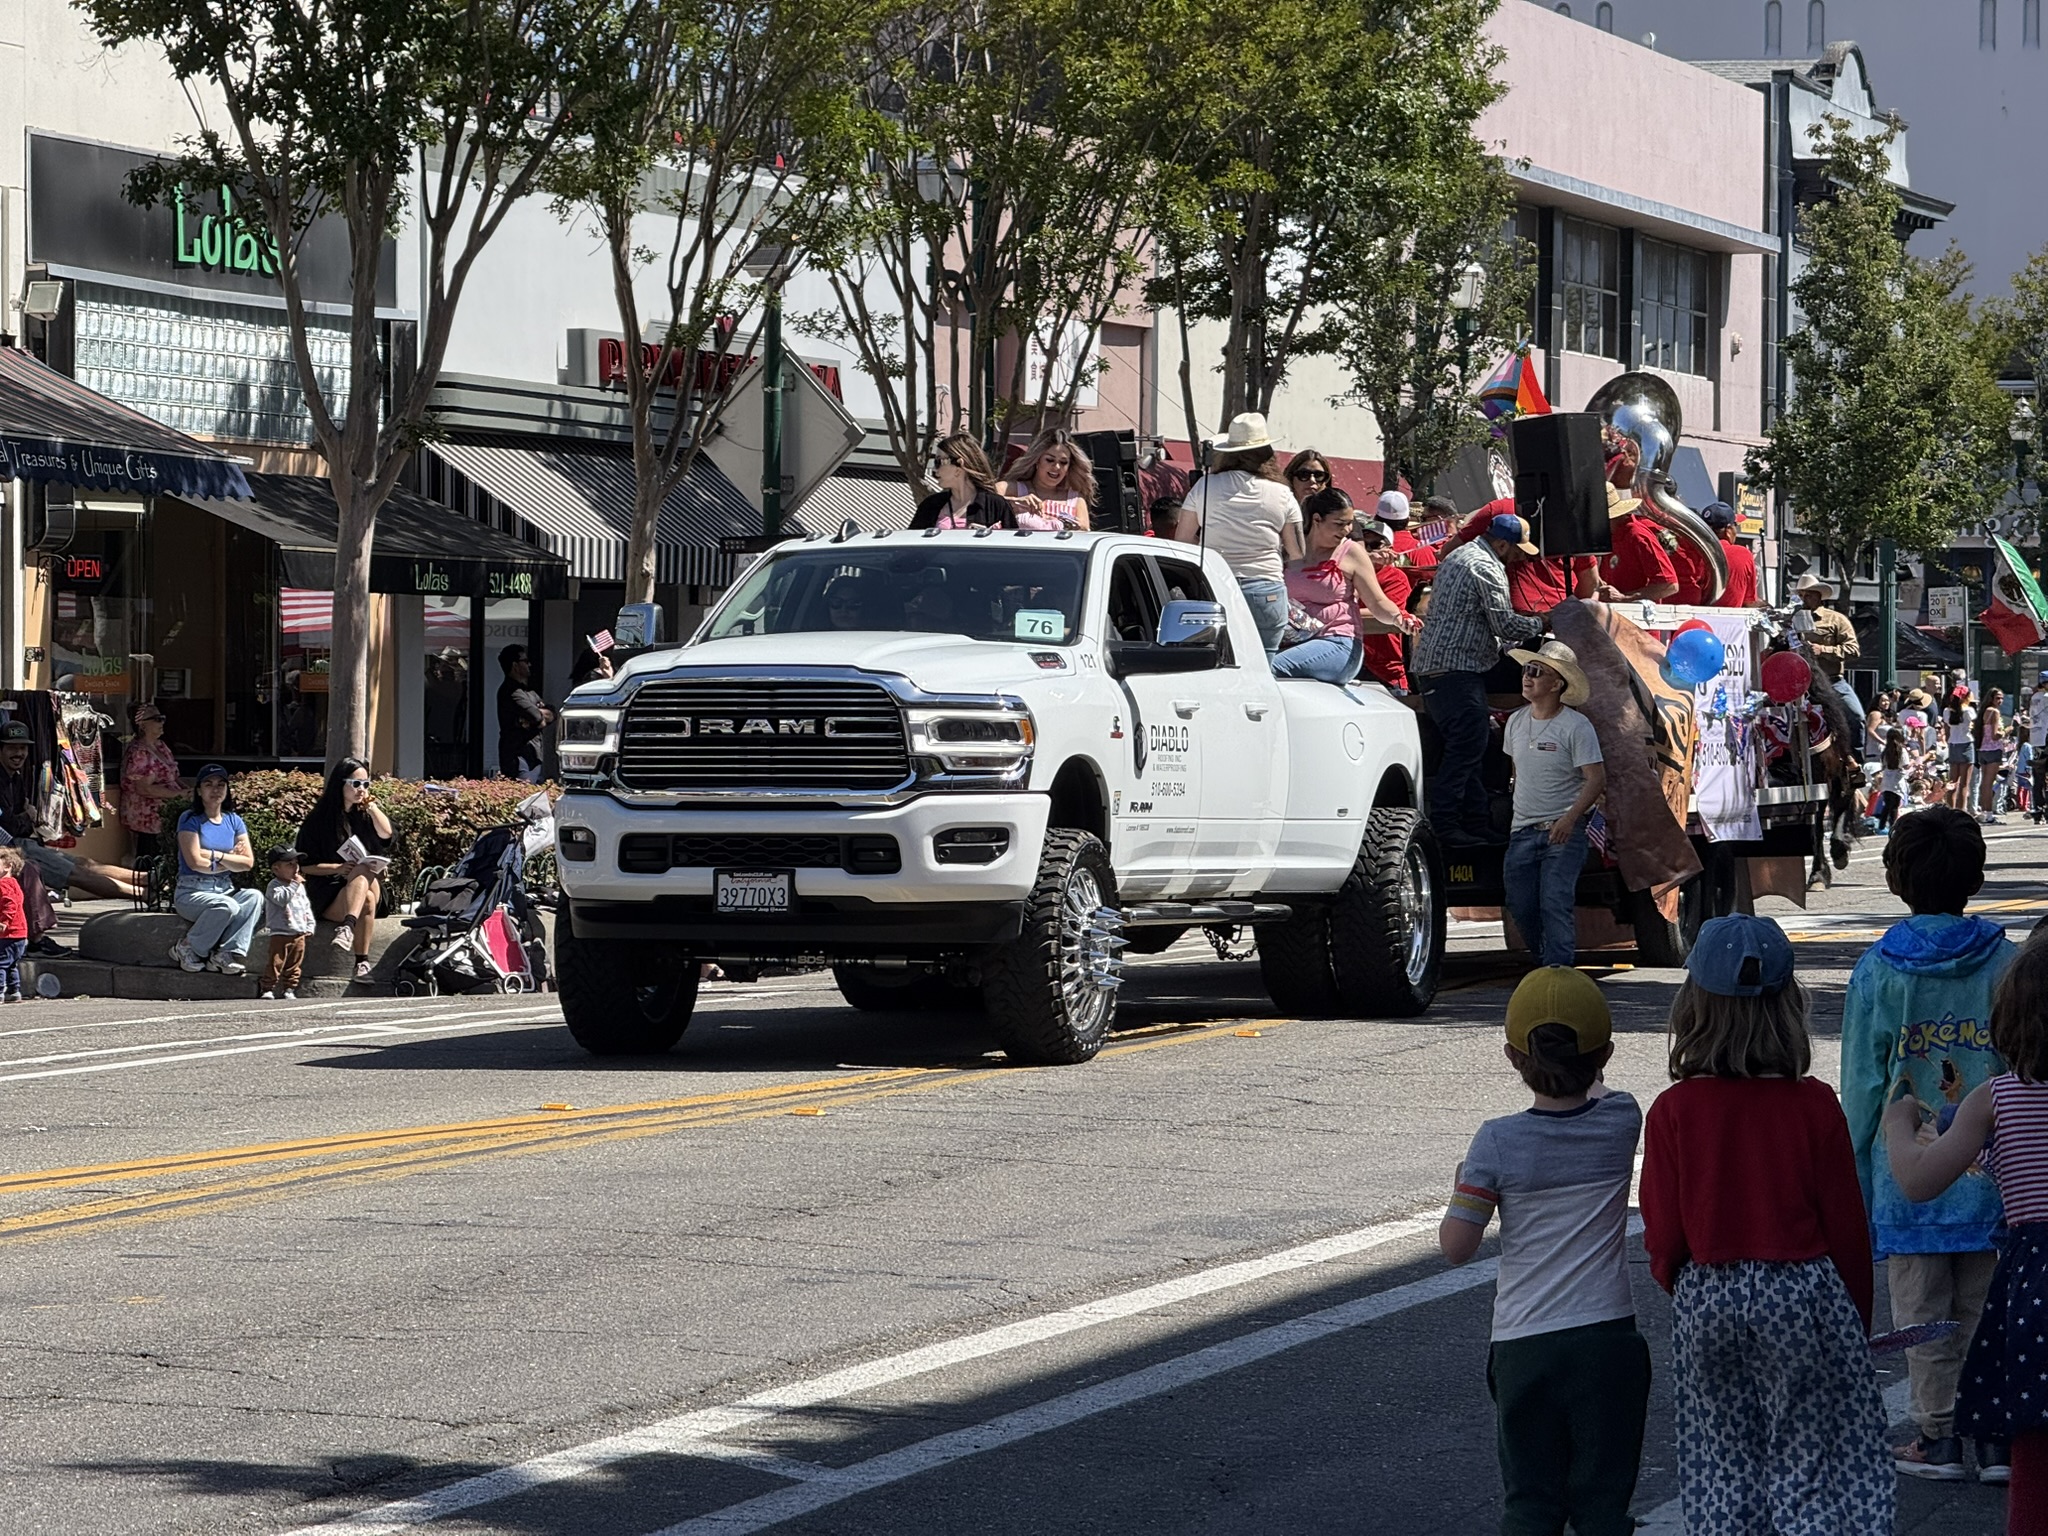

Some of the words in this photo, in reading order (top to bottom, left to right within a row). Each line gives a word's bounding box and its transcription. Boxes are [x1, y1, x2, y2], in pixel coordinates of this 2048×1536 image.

[8, 440, 67, 470] Treasures
[70, 454, 79, 471] &
[82, 450, 124, 485] Unique
[125, 454, 158, 481] Gifts
[67, 559, 100, 577] OPEN
[415, 562, 449, 591] Lola's
[489, 572, 532, 595] 521-4488
[1930, 598, 1940, 606] 20
[1947, 597, 1956, 605] 21
[1027, 619, 1053, 635] 76
[1080, 653, 1096, 668] 121
[699, 718, 816, 735] RAM
[1151, 725, 1189, 752] DIABLO
[1449, 865, 1474, 882] 140A
[721, 887, 786, 906] 39770X3
